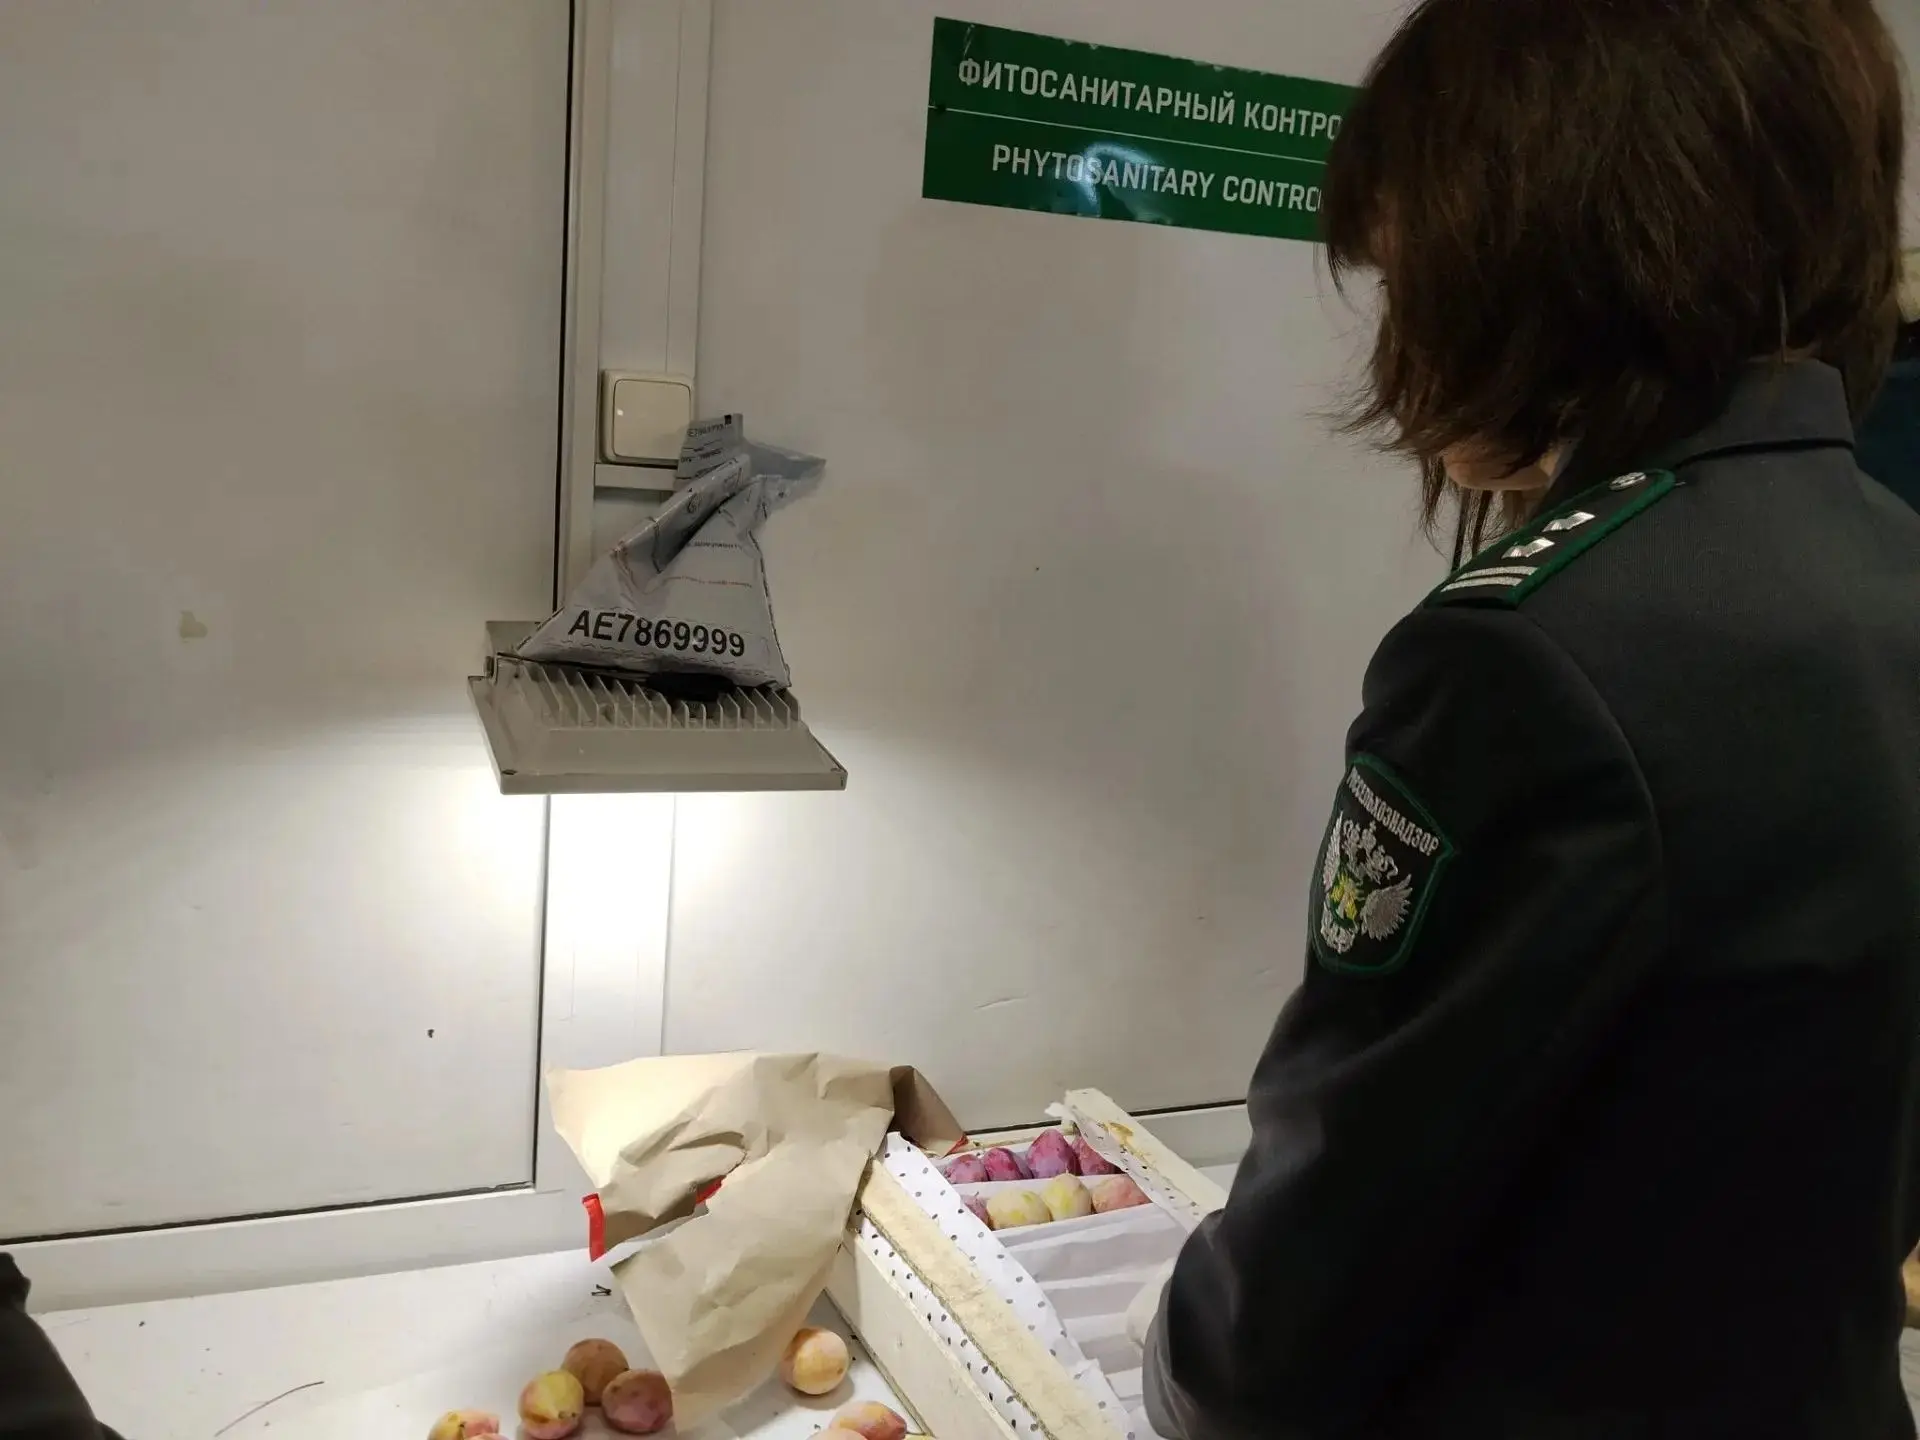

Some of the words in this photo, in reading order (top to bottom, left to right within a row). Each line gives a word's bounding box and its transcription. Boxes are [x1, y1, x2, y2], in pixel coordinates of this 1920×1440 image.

[958, 58, 1235, 125] ФИТОСАНИТАРНЫЙ
[992, 144, 1215, 198] PHYTOSANITARY
[568, 609, 745, 657] AE7869999
